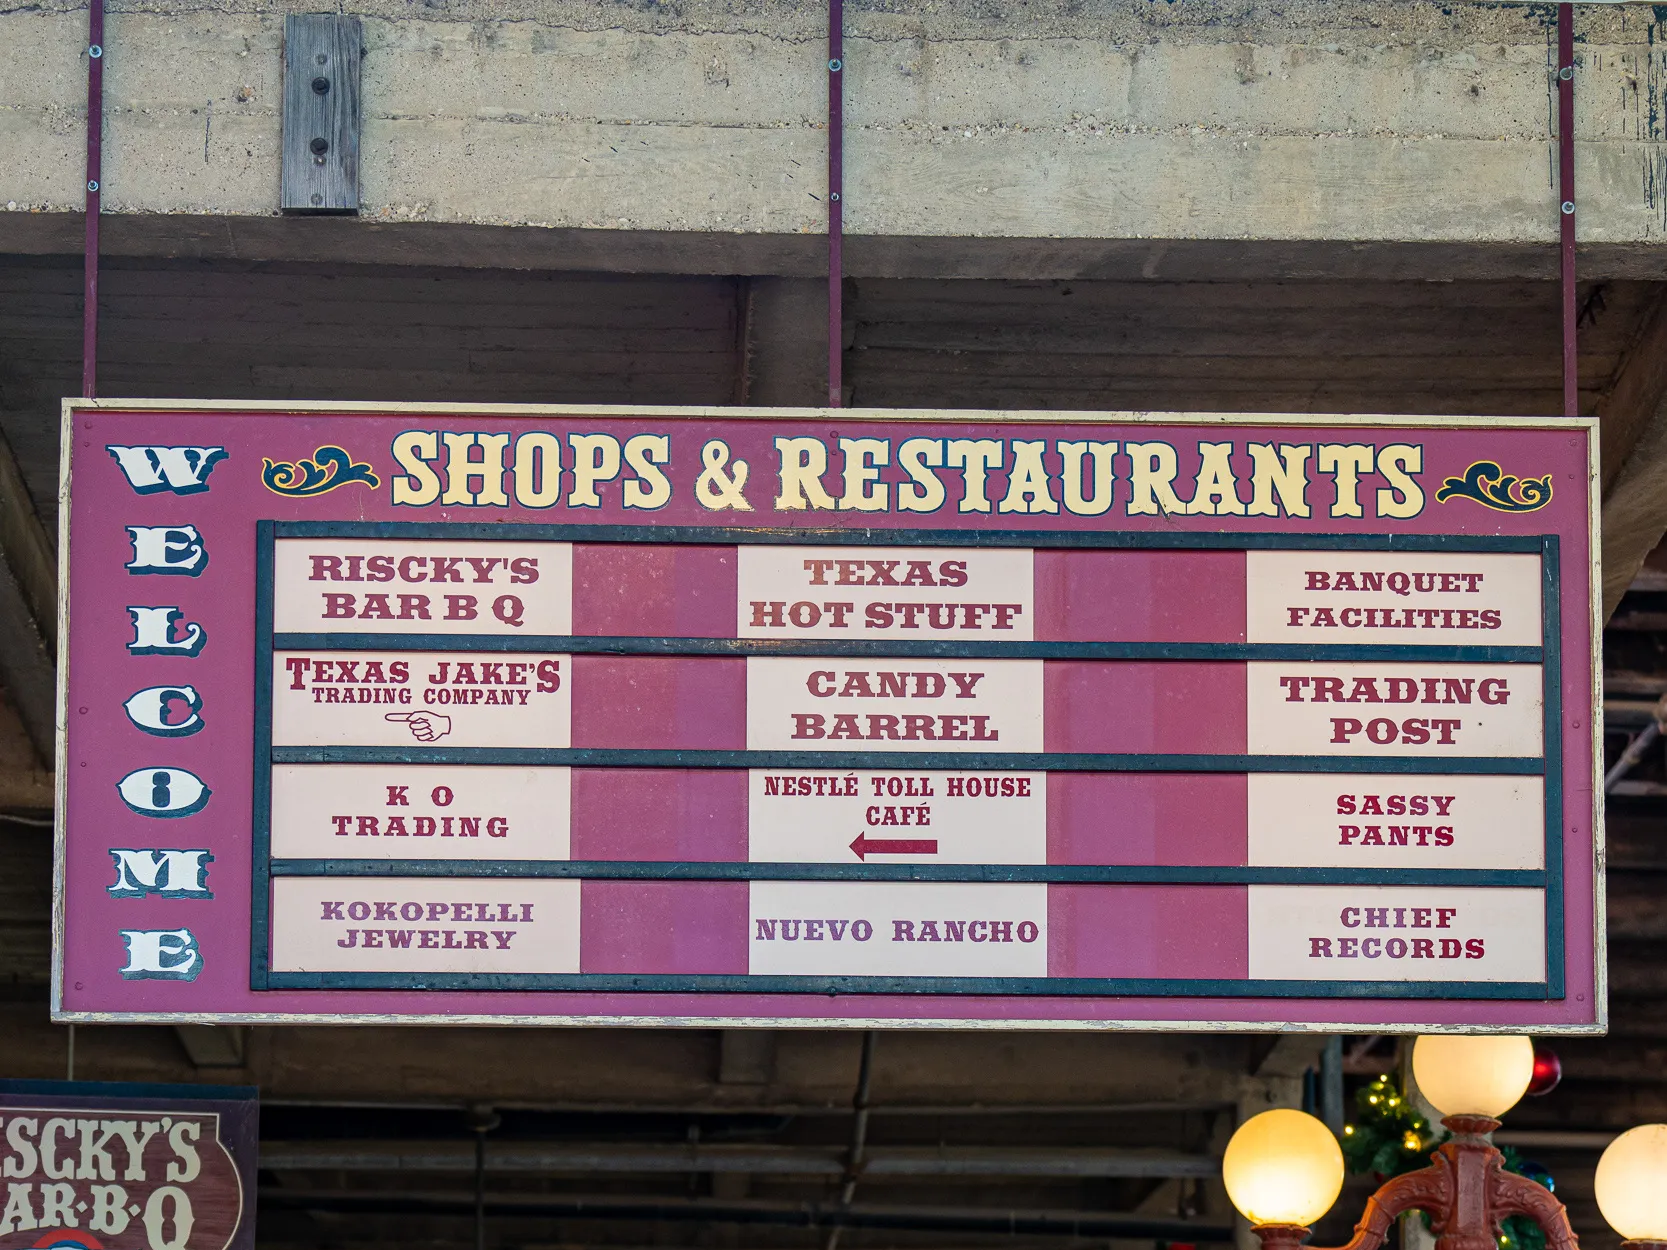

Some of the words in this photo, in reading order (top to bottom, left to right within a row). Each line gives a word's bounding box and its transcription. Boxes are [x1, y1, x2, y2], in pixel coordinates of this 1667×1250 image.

[391, 430, 673, 512] SHOPS
[695, 437, 756, 513] &
[773, 435, 1426, 520] RESTAURANTS
[309, 555, 539, 584] RISCKY'S
[804, 560, 968, 587] TEXAS
[1305, 571, 1483, 596] BANQUET
[322, 592, 432, 620] BAR
[443, 594, 479, 621] B
[491, 595, 525, 627] Q
[750, 601, 854, 628] HOT
[865, 602, 1022, 629] STUFF
[1287, 607, 1501, 629] FACILITIES
[286, 657, 410, 691] TEXAS
[428, 659, 561, 693] JAKE'S
[806, 671, 984, 698] CANDY
[312, 687, 412, 704] TRADING
[423, 688, 531, 705] COMPANY
[1280, 677, 1510, 705] TRADING
[105, 443, 229, 983] WELCOME
[791, 714, 998, 741] BARREL
[1330, 718, 1461, 744] POST
[386, 786, 409, 806] K
[431, 786, 454, 806] O
[764, 771, 858, 797] NESTLÉ
[871, 776, 934, 797] TOLL
[946, 777, 1031, 798] HOUSE
[865, 801, 931, 826] CAFÉ
[1337, 795, 1455, 816] SASSY
[332, 816, 509, 837] TRADING
[1339, 825, 1454, 846] PANTS
[321, 901, 534, 922] KOKOPELLI
[1340, 907, 1456, 928] CHIEF
[337, 929, 517, 949] JEWELRY
[756, 919, 873, 941] NUEVO
[892, 920, 1039, 943] RANCHO
[1309, 938, 1485, 959] RECORDS
[0, 1116, 200, 1183] SCKY'S
